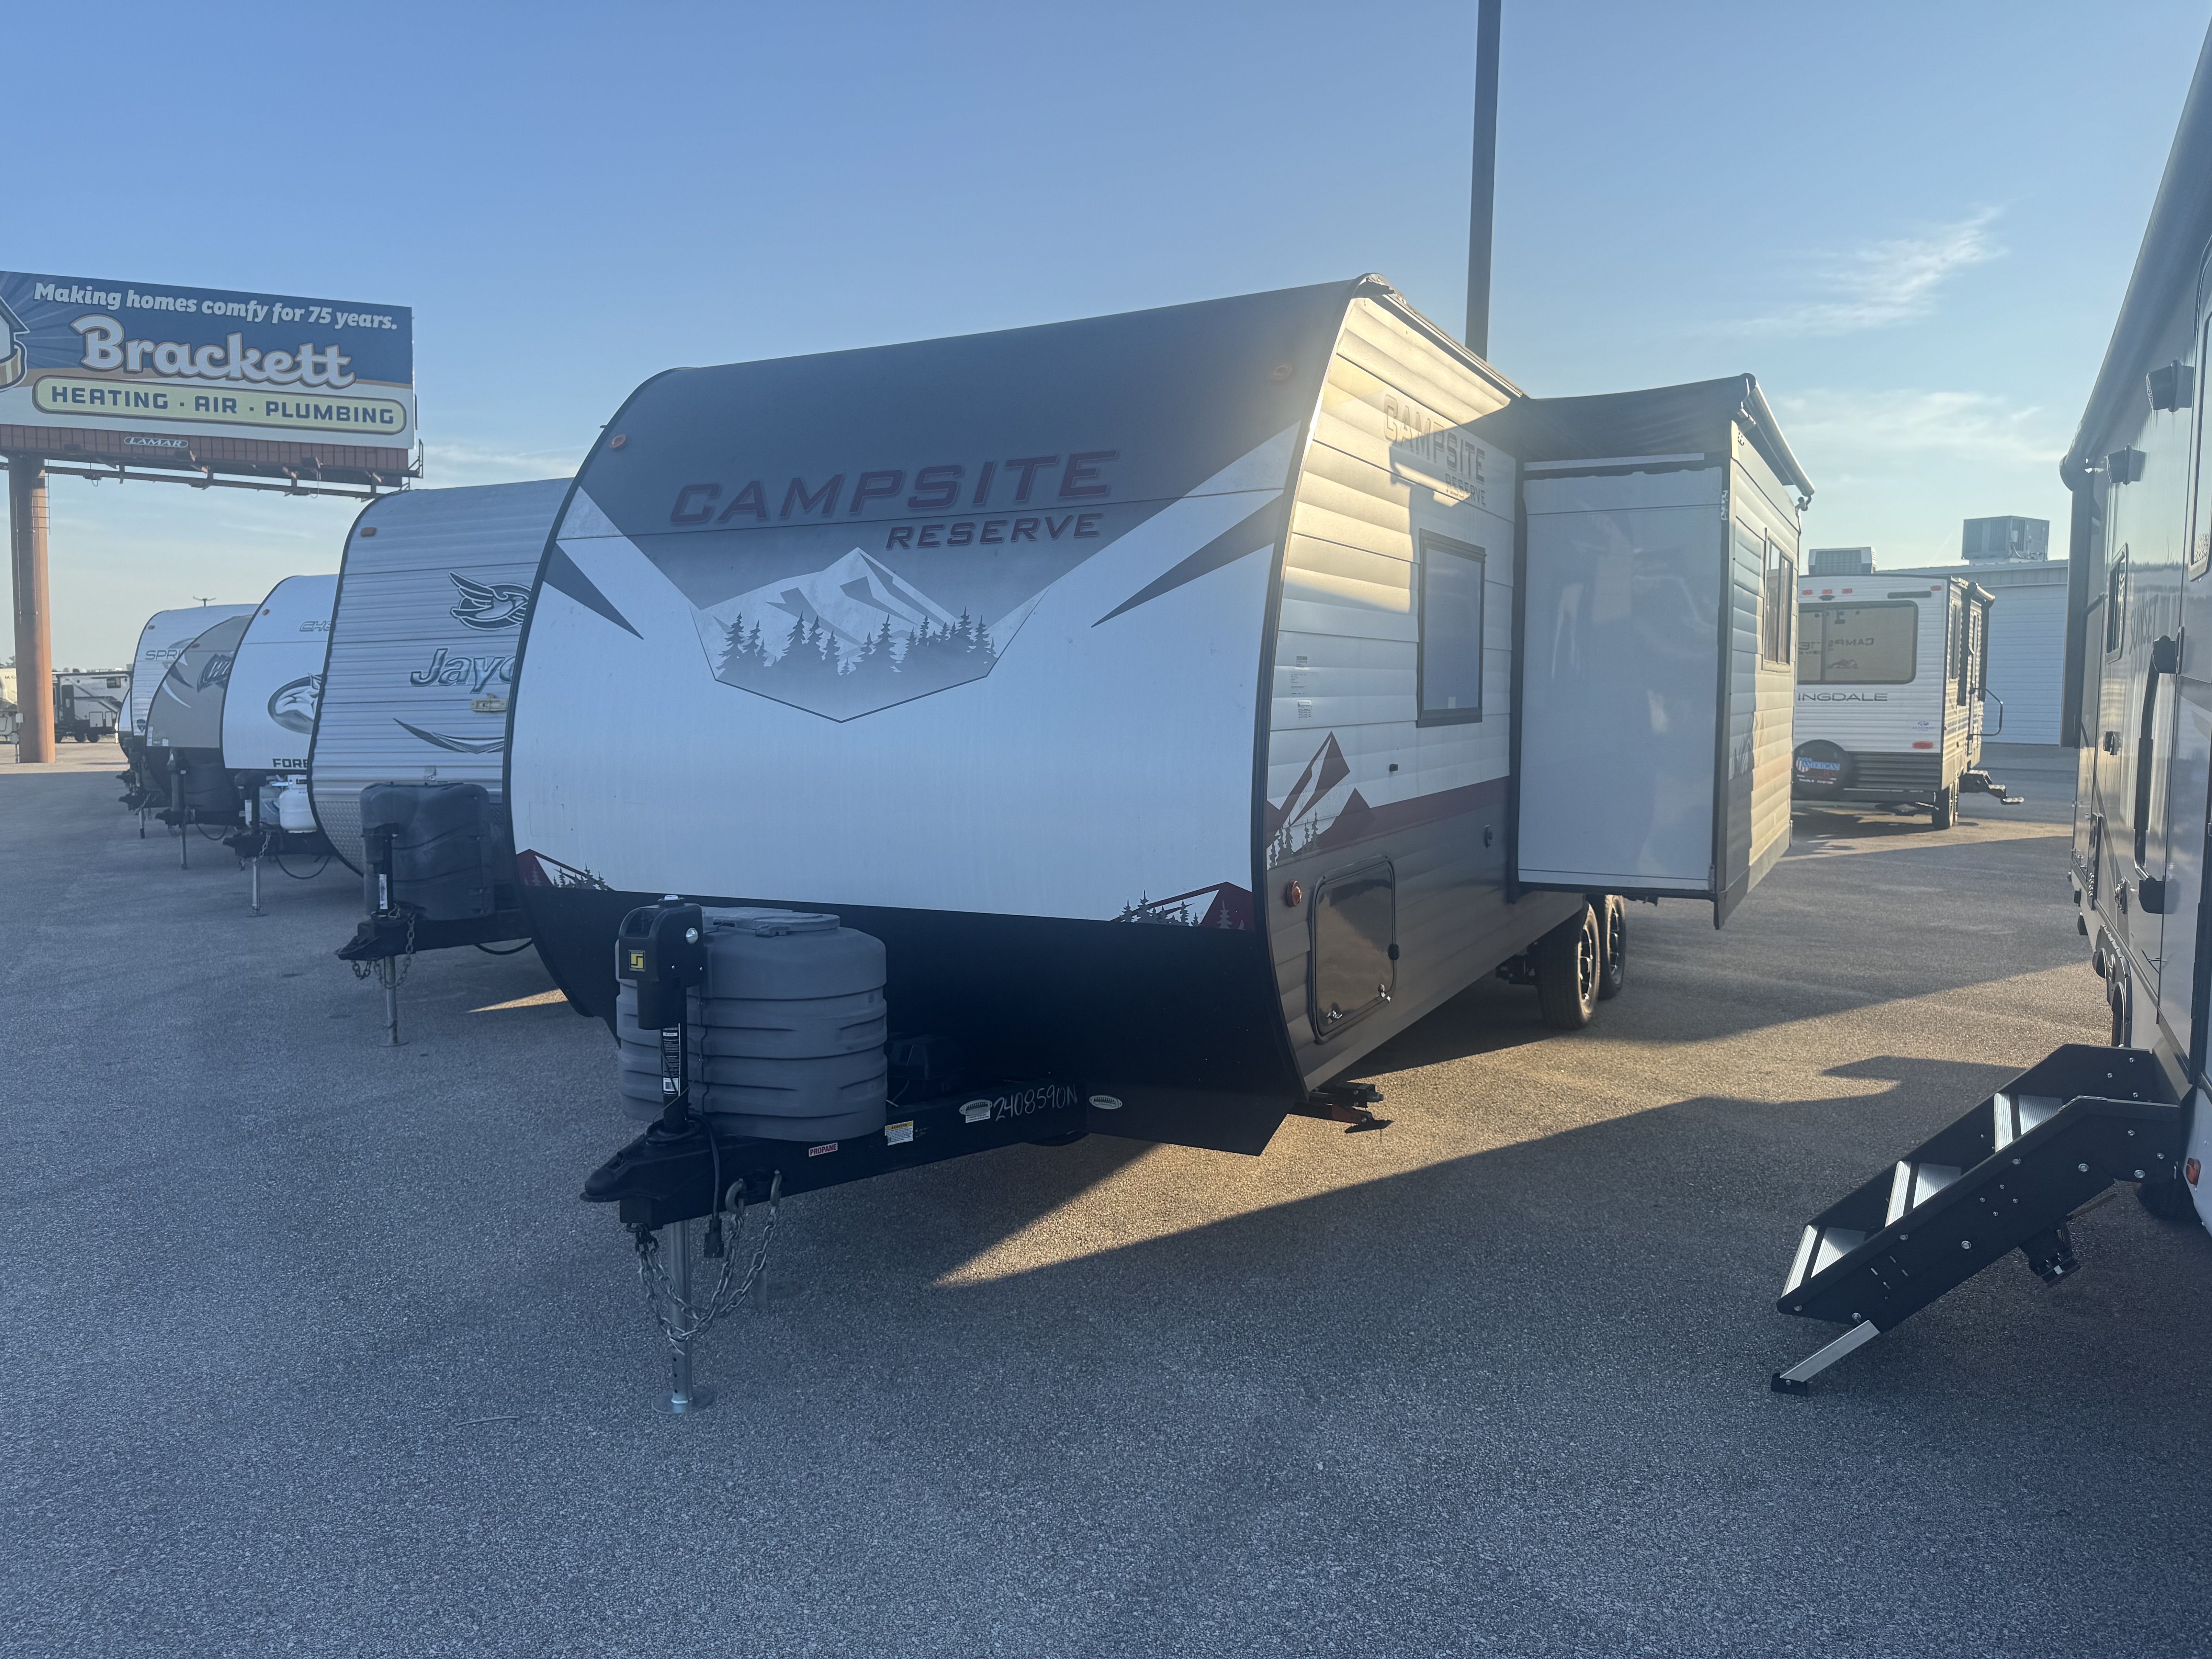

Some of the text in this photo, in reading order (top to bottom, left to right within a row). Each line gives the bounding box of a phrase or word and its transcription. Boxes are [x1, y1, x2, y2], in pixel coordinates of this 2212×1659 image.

[34, 282, 397, 330] Making homes comfy for 75 years.
[71, 314, 356, 388] Brackett
[52, 386, 394, 424] HEATING AIR PLUMBING
[130, 438, 182, 447] LAMAR
[1384, 394, 1485, 483] CAMPSITE
[669, 449, 1118, 524] CAMPSITE
[1445, 473, 1486, 506] RESERVE
[885, 512, 1104, 549] RESERVE
[2129, 594, 2159, 655] SUNSET
[1798, 693, 1887, 701] INGDALE
[1802, 761, 1840, 770] AMERICAN
[994, 1083, 1078, 1121] 2408590N
[810, 1144, 837, 1156] PROPANE
